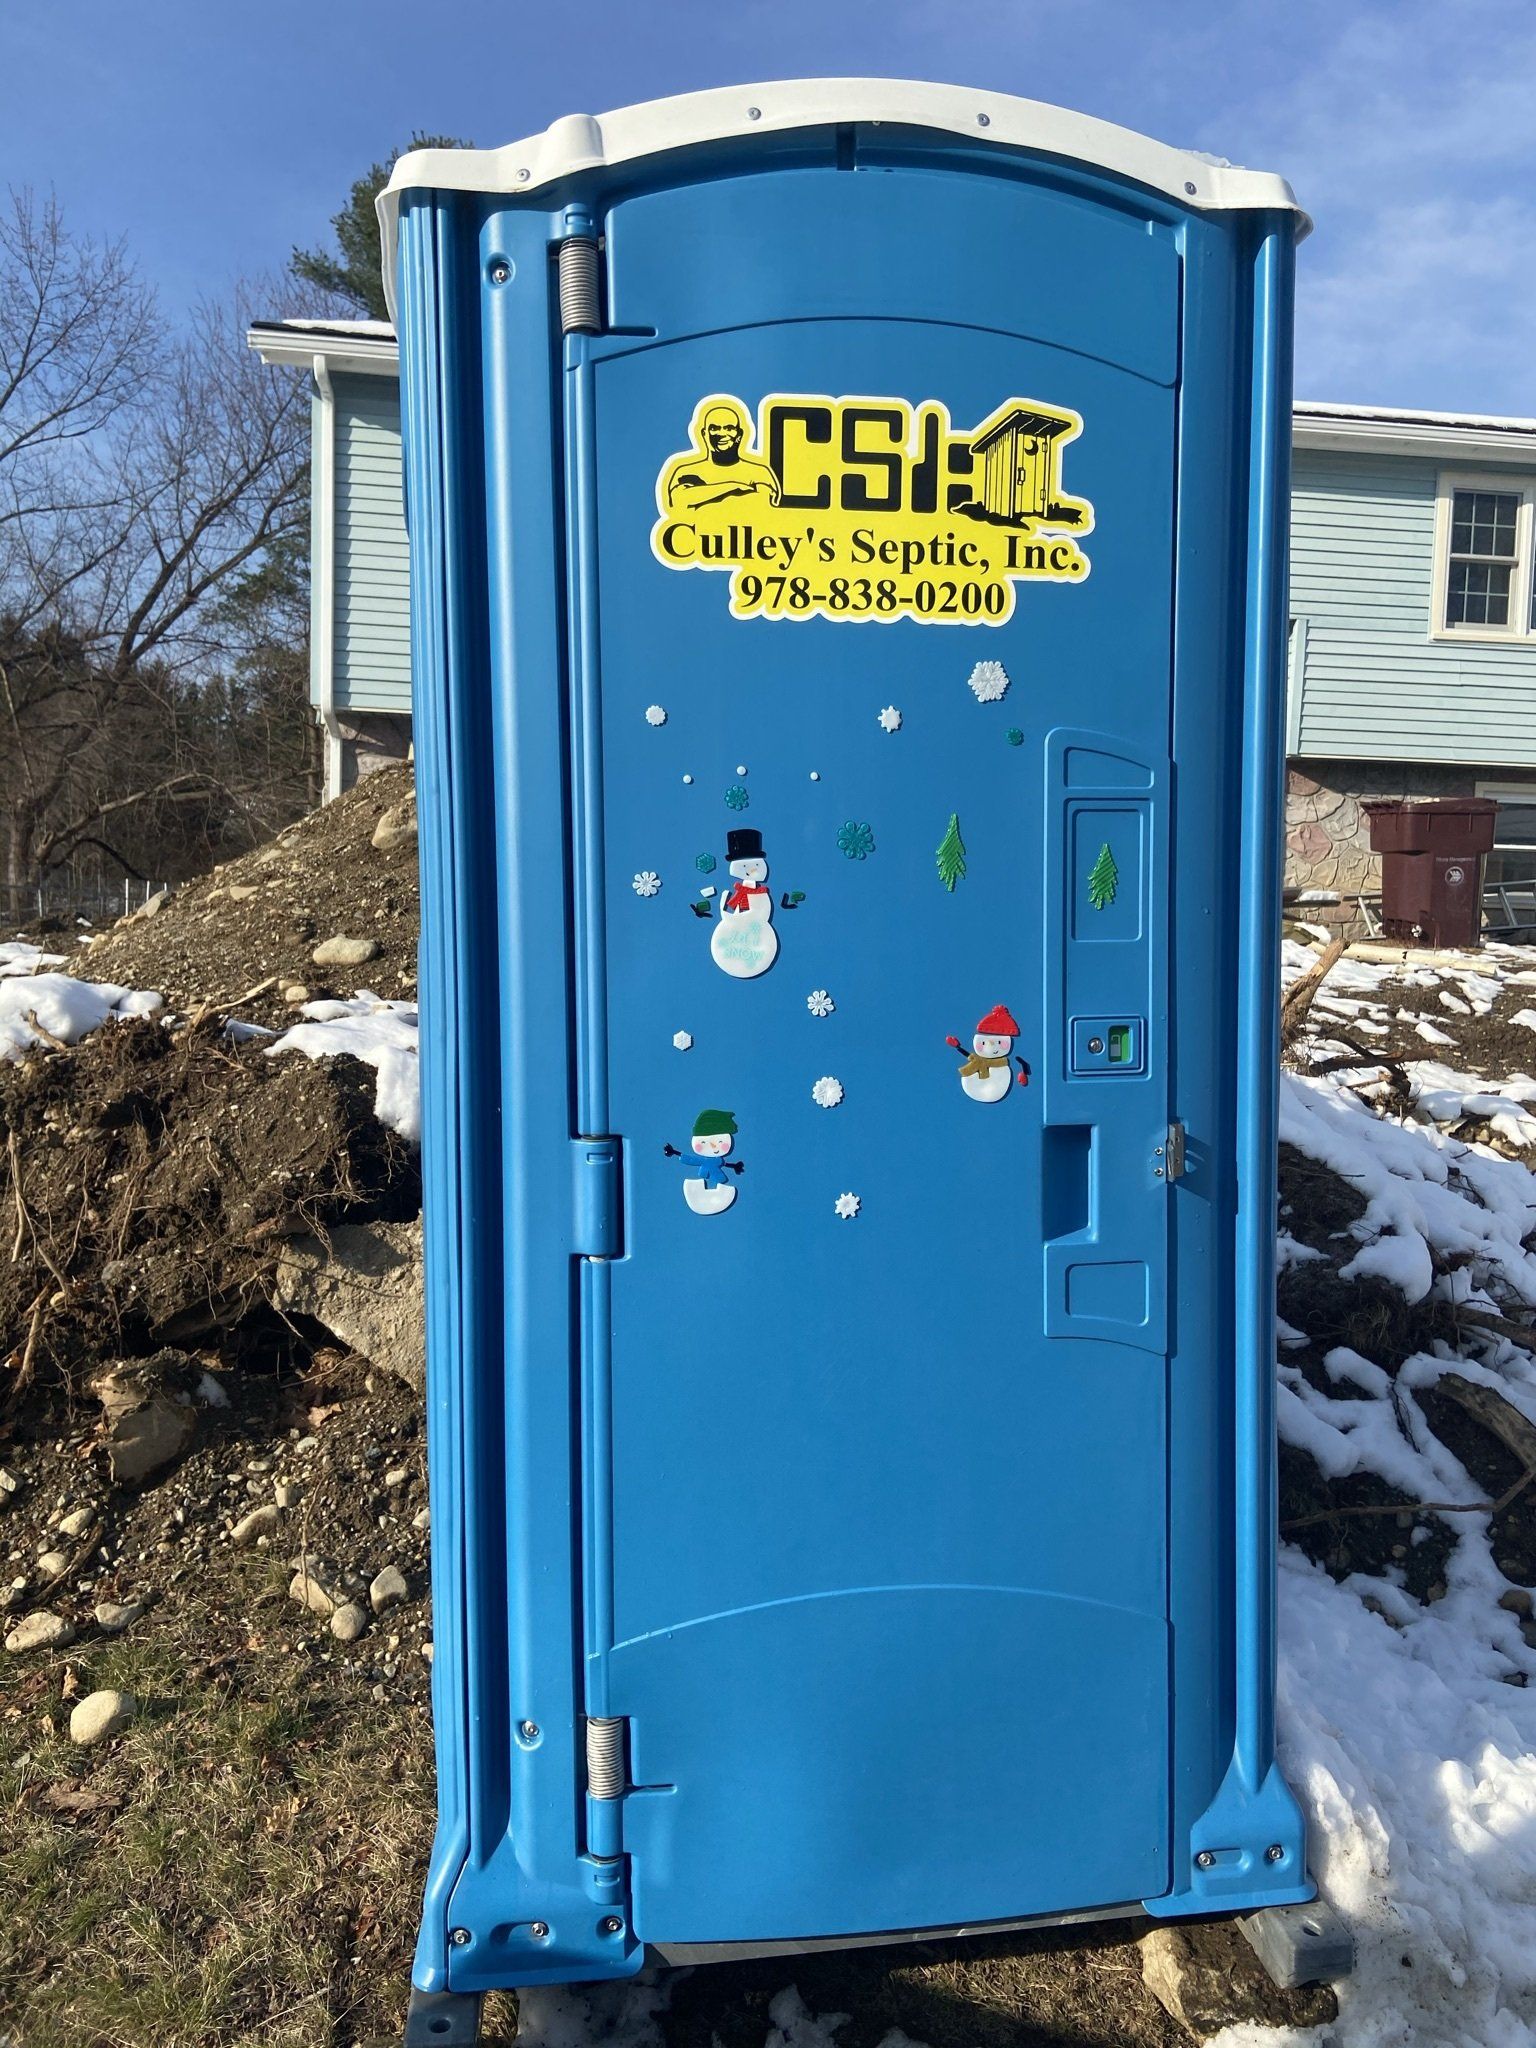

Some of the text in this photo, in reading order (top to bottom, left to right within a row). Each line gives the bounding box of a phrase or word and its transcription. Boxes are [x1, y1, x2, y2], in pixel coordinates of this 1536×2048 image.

[662, 523, 1081, 575] Culley's Septic, Inc.
[741, 575, 1005, 615] 978-838-0200
